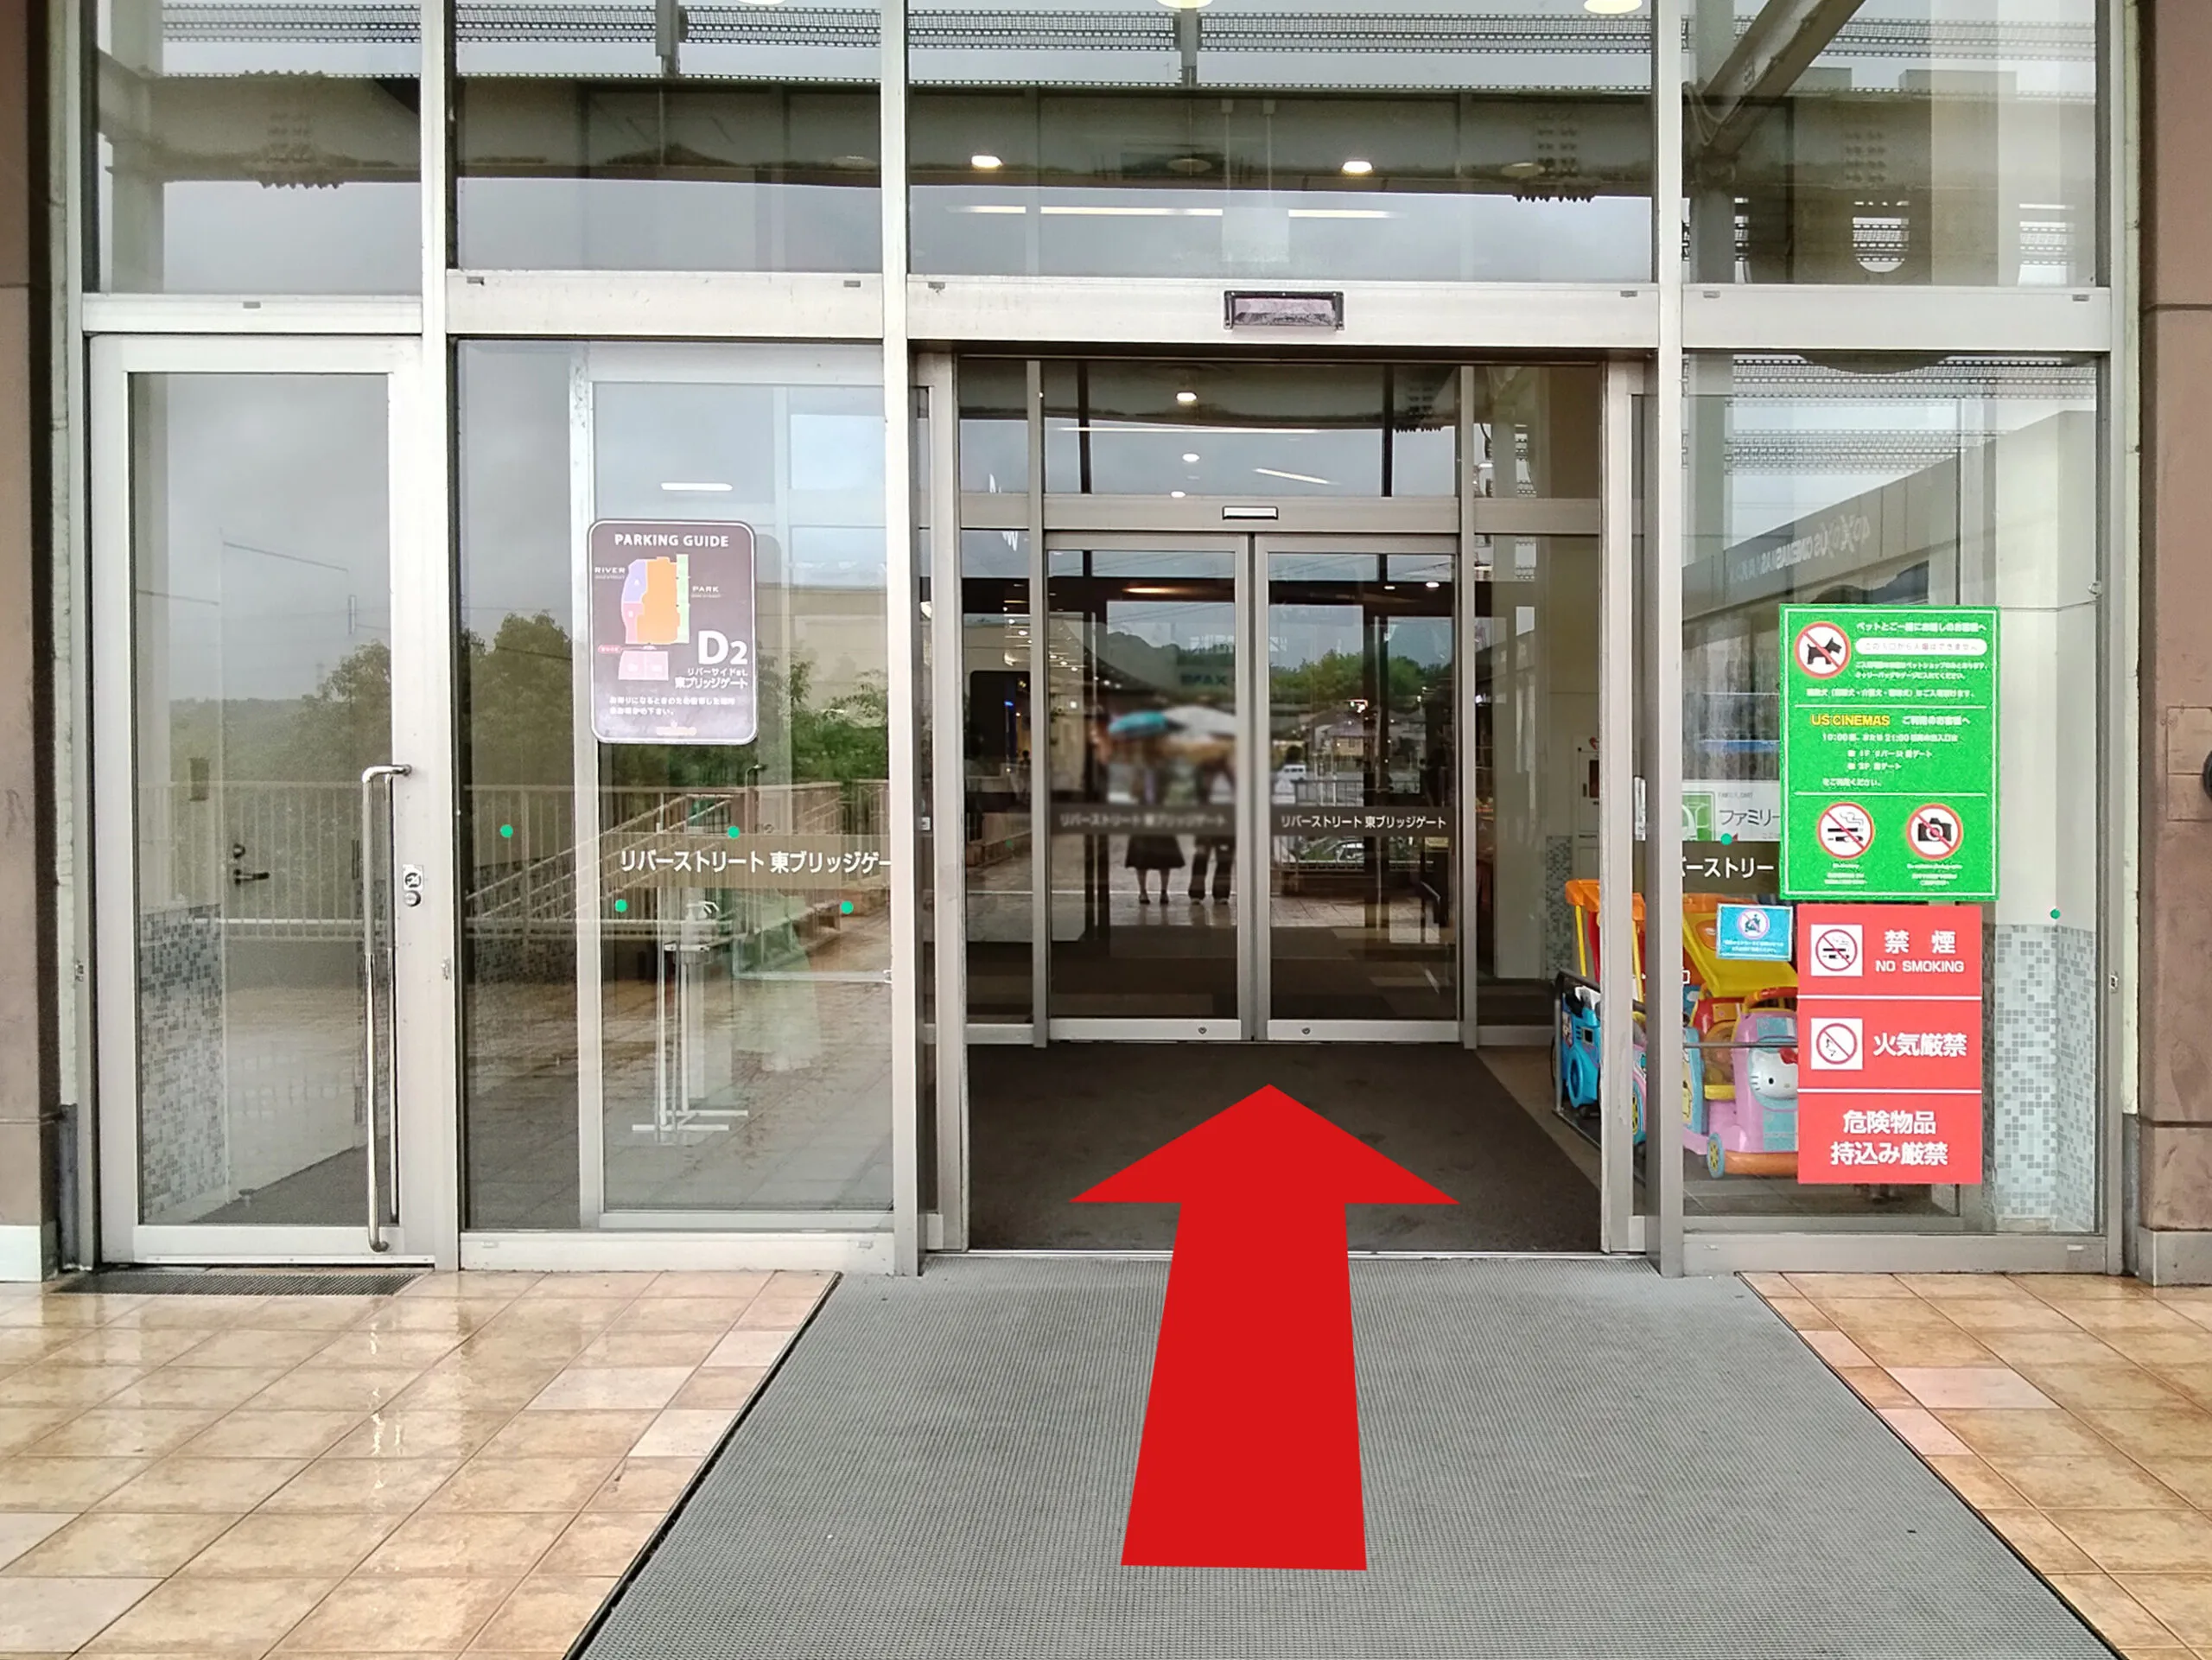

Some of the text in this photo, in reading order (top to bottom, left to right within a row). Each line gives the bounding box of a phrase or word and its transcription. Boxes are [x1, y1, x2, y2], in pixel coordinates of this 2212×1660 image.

[614, 533, 729, 548] PARKING GUIDE
[697, 630, 748, 665] D2
[1810, 714, 1891, 727] US CINEMAS
[1281, 815, 1447, 830] リバーストリート 東ブリッジゲート
[620, 849, 765, 873] リバーストリート
[1875, 960, 1965, 973] NO SMOKING
[1872, 1032, 1967, 1058] 火気厳禁
[1842, 1110, 1937, 1135] 危険物品
[1830, 1141, 1948, 1167] 持込み厳禁
